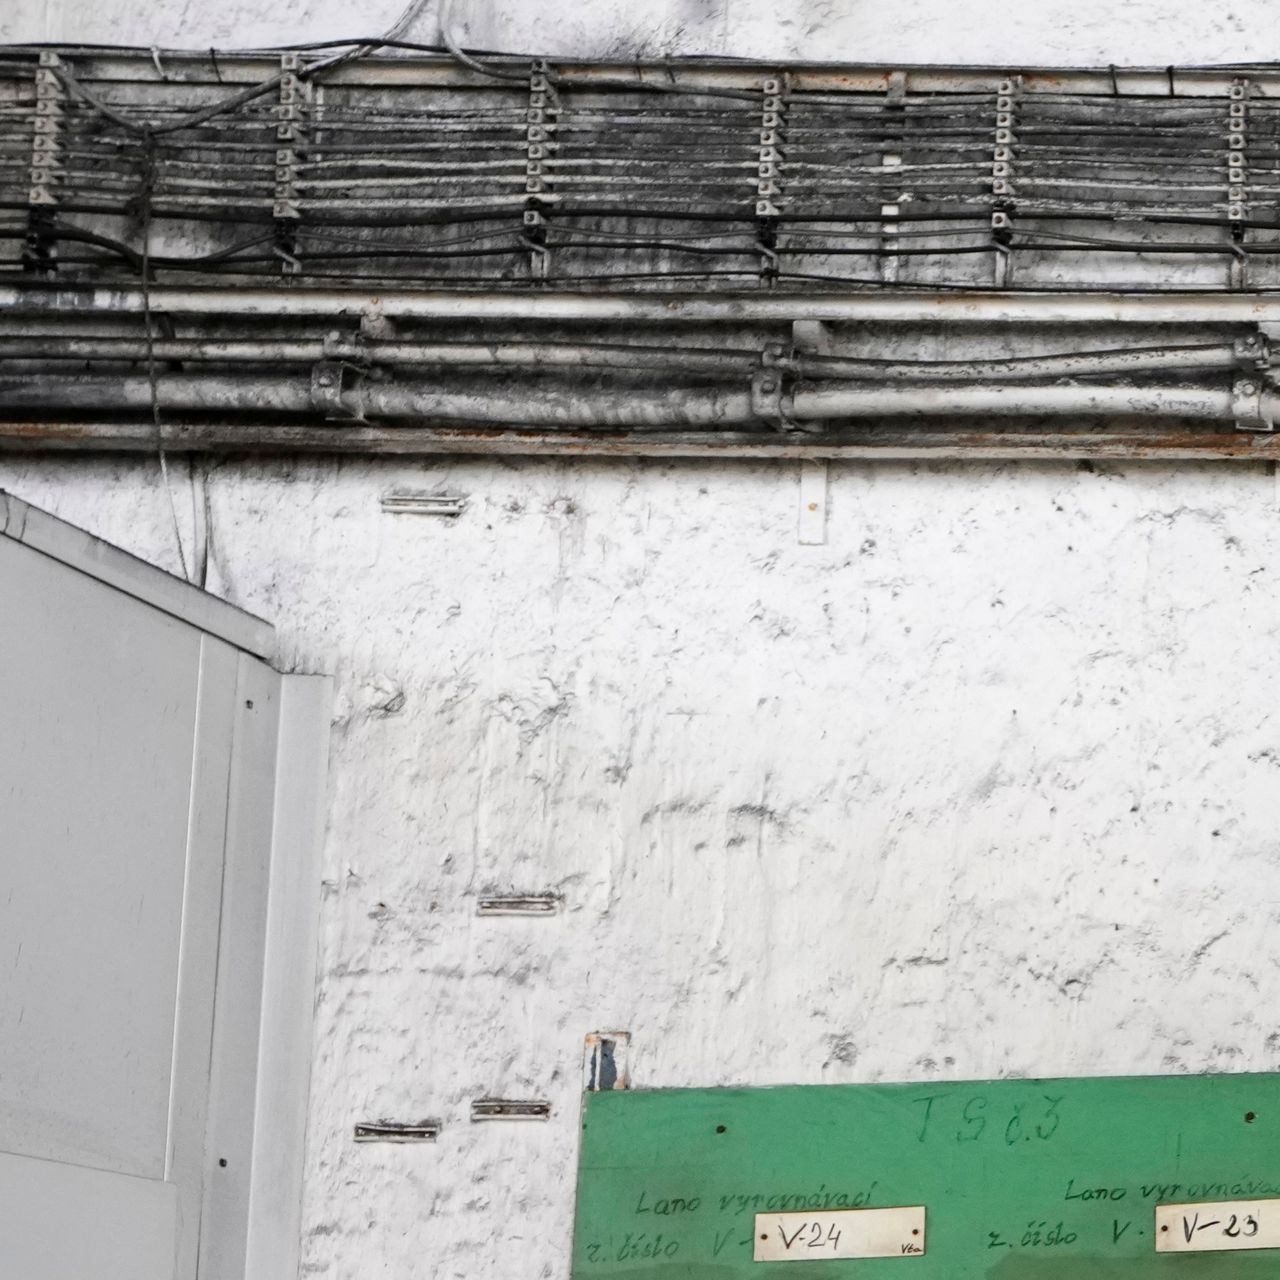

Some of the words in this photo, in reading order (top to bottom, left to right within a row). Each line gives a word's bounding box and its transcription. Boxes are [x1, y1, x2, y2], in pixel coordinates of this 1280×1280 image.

[636, 1191, 701, 1216] Lano
[1064, 1179, 1127, 1201] Lano
[778, 1222, 842, 1250] V-24
[1020, 1219, 1078, 1247] číslo
[1183, 1211, 1260, 1243] V-23
